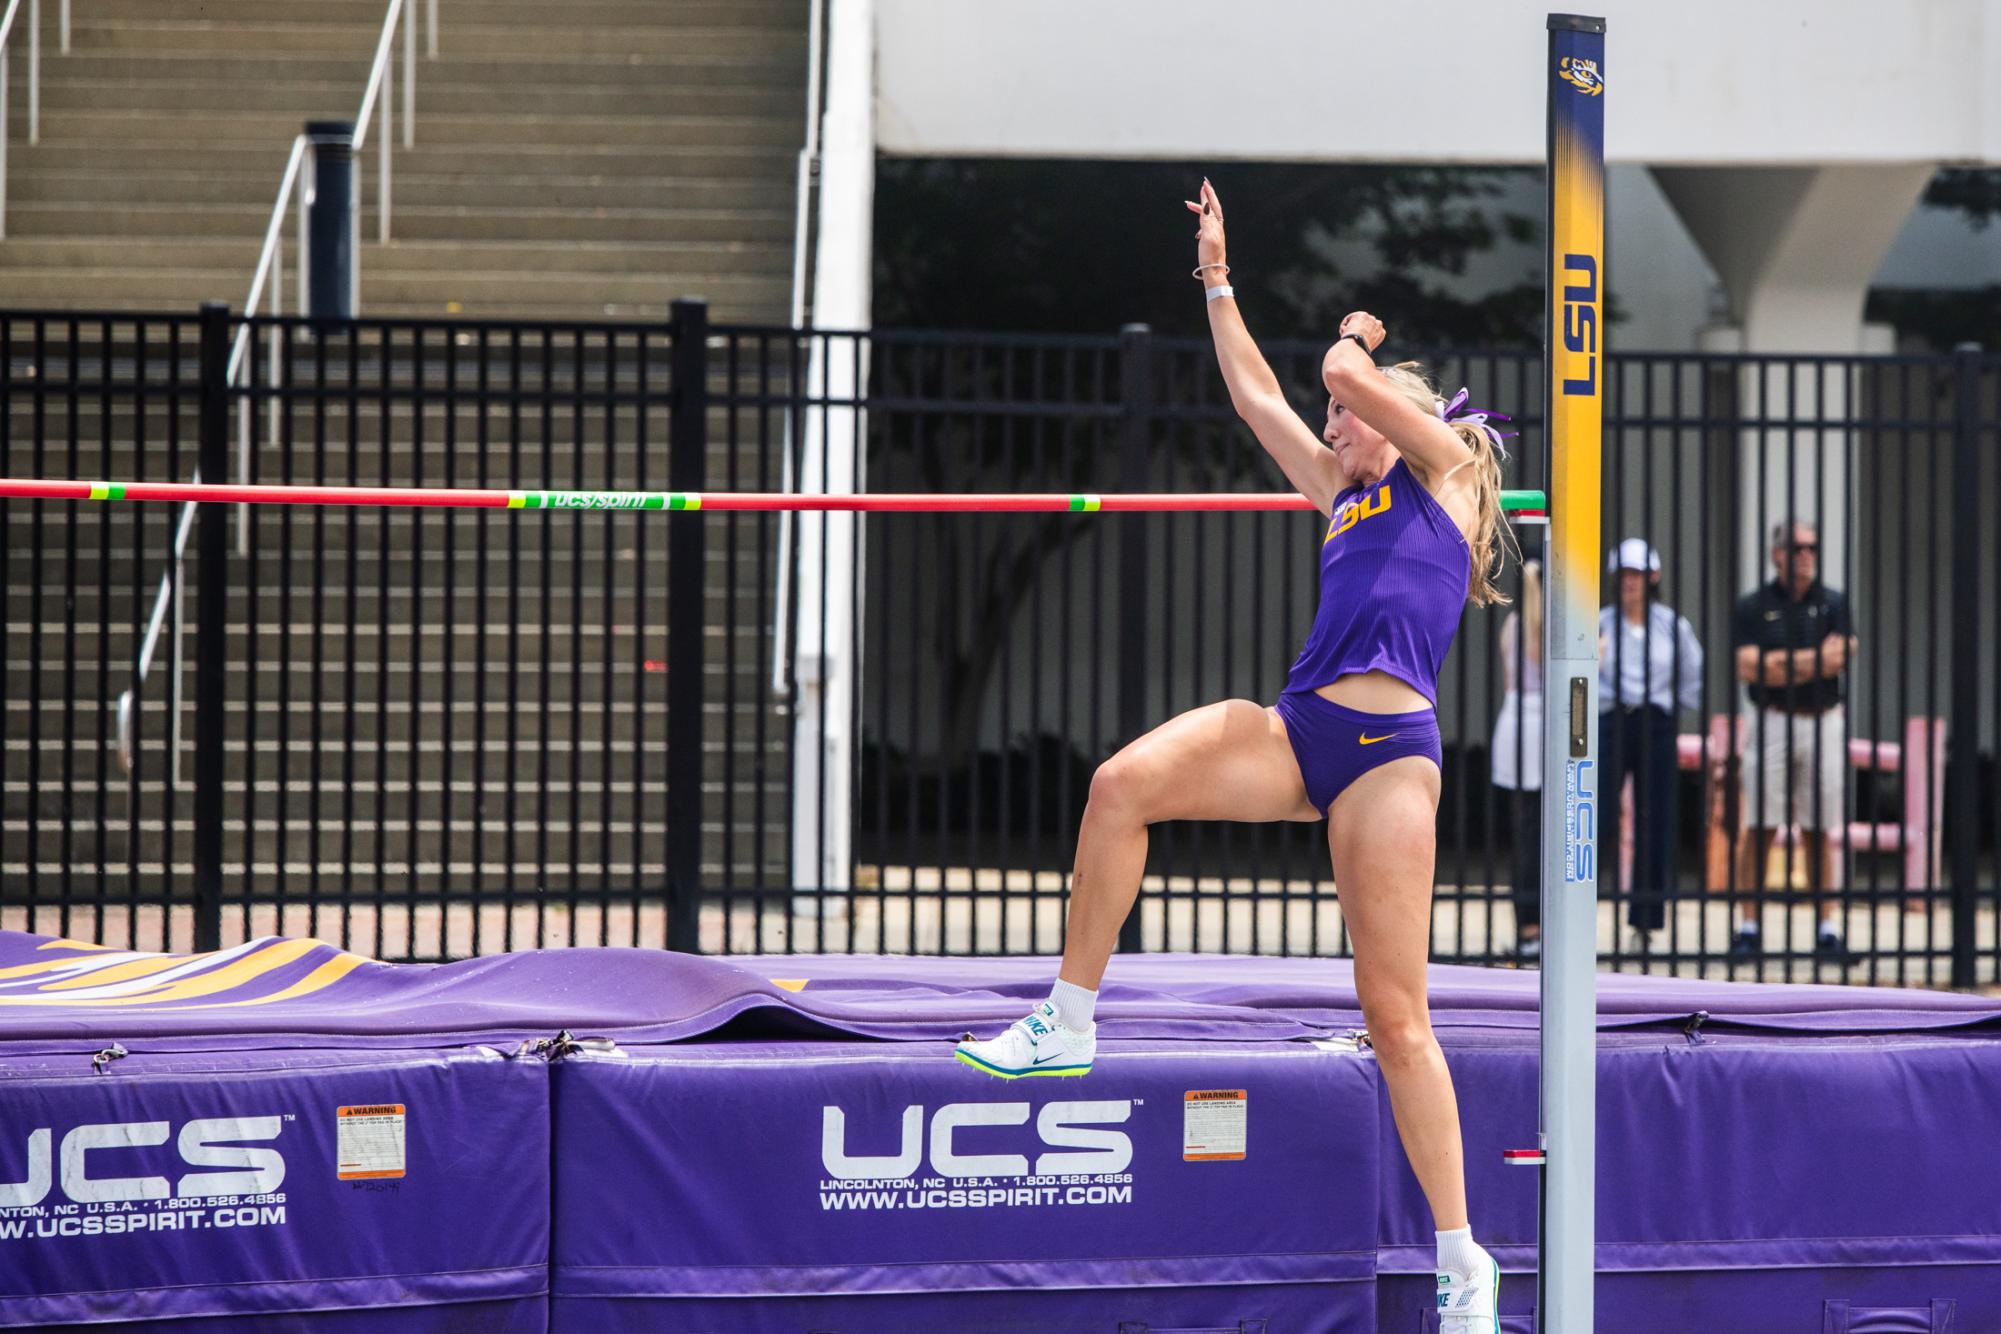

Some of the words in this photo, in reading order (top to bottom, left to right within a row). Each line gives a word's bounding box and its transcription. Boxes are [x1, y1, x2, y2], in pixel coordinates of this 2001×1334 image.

[1563, 254, 1597, 396] LSU
[1324, 485, 1392, 544] LSU
[1575, 760, 1594, 881] UCS
[1199, 1091, 1239, 1099] WARNING
[353, 1106, 397, 1115] WARNING
[821, 1100, 1134, 1179] UCS
[820, 1178, 919, 1190] LINCOLNTON,
[923, 1178, 946, 1188] NC
[952, 1177, 998, 1187] U.S.A.
[1013, 1174, 1133, 1186] 1.800.526.4856
[54, 1204, 79, 1215] NC
[86, 1201, 138, 1213] U.S.A.
[154, 1193, 286, 1210] 1.800.526.4856
[819, 1185, 1132, 1210] WWW.UCSSPIRIT.COM
